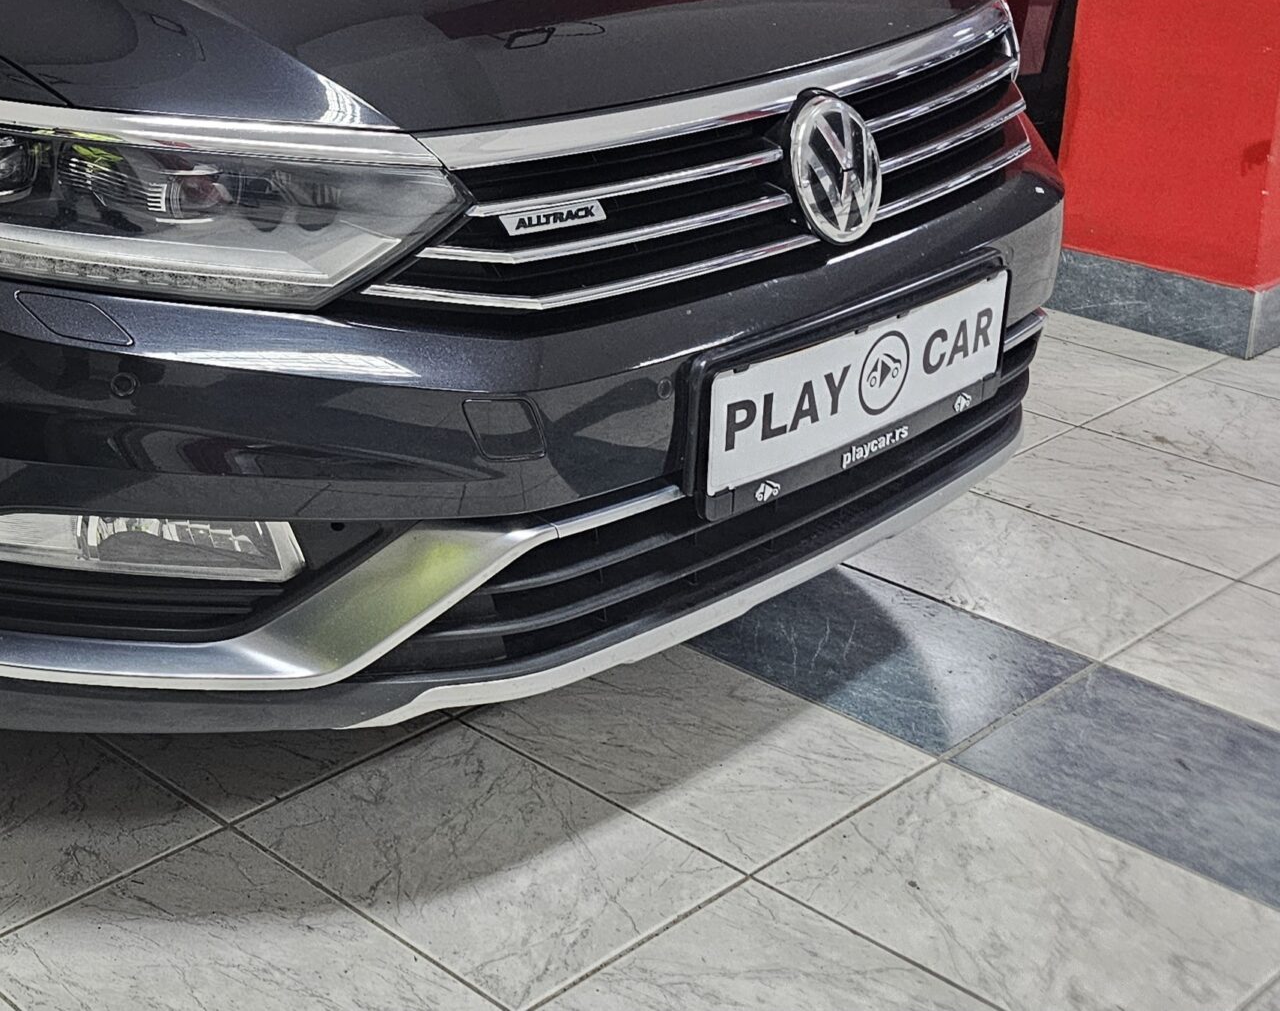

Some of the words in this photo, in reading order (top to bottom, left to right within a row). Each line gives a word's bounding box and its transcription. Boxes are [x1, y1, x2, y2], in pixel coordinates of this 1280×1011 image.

[515, 205, 595, 230] ALLTRACK
[723, 364, 851, 452] PLAY
[922, 307, 993, 375] CAR
[841, 424, 909, 469] playcar.rs
